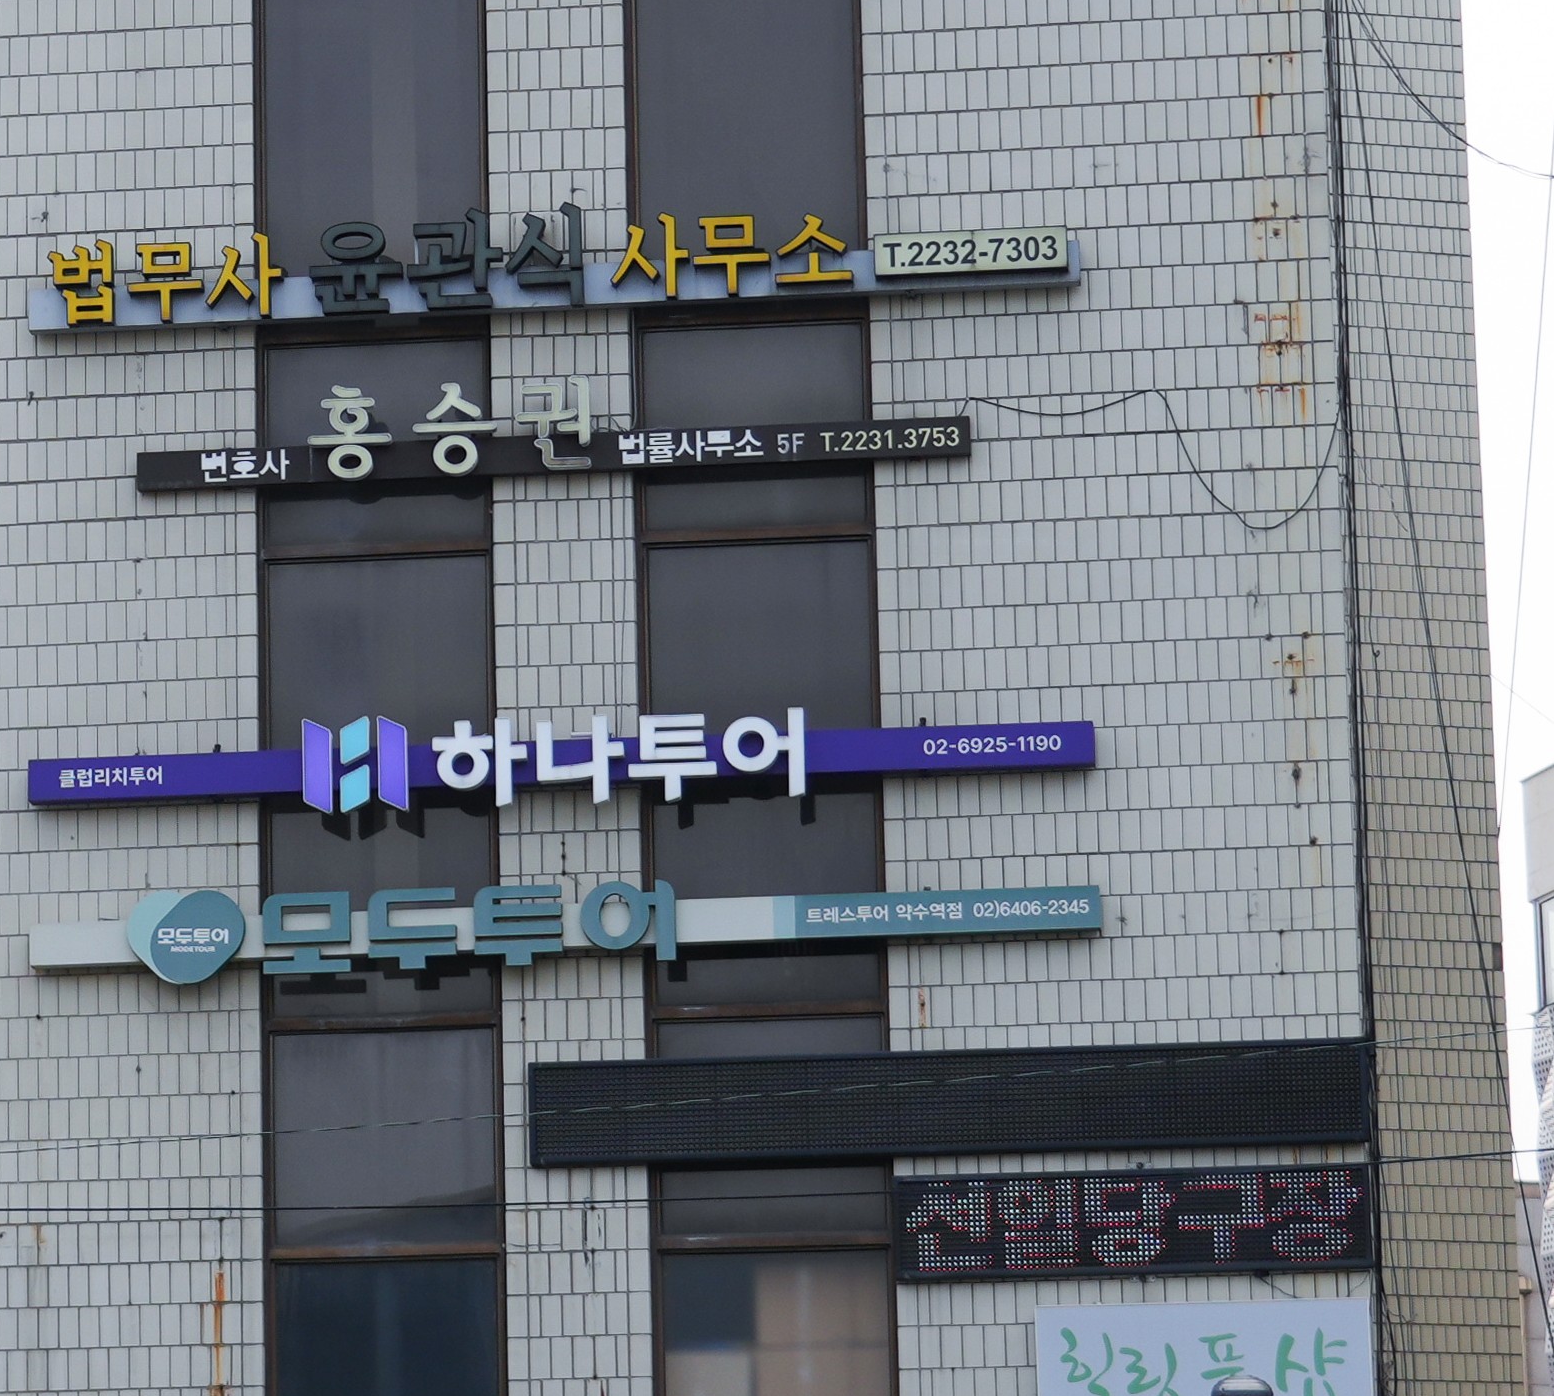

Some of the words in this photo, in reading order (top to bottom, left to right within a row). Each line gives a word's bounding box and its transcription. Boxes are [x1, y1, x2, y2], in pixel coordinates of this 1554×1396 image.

[48, 233, 287, 327] 법무사
[307, 201, 590, 316] 윤관식
[610, 211, 855, 299] 사무소
[882, 234, 1059, 271] T.2232-7303
[200, 447, 291, 485] 변호사
[617, 429, 764, 466] 법률사무소
[776, 433, 805, 455] 5F
[818, 425, 960, 455] T.2231.3753
[58, 763, 164, 789] 클럽리치투어
[433, 707, 807, 808] 하나투어
[922, 734, 1062, 757] 02-6925-1190
[156, 924, 231, 946] 모두투어
[262, 879, 678, 974] 모두투어
[805, 900, 890, 925] 트레스투어
[894, 898, 964, 922] 약수역점
[973, 896, 1091, 921] 02)6406-2345
[905, 1168, 1364, 1272] 선일당구장
